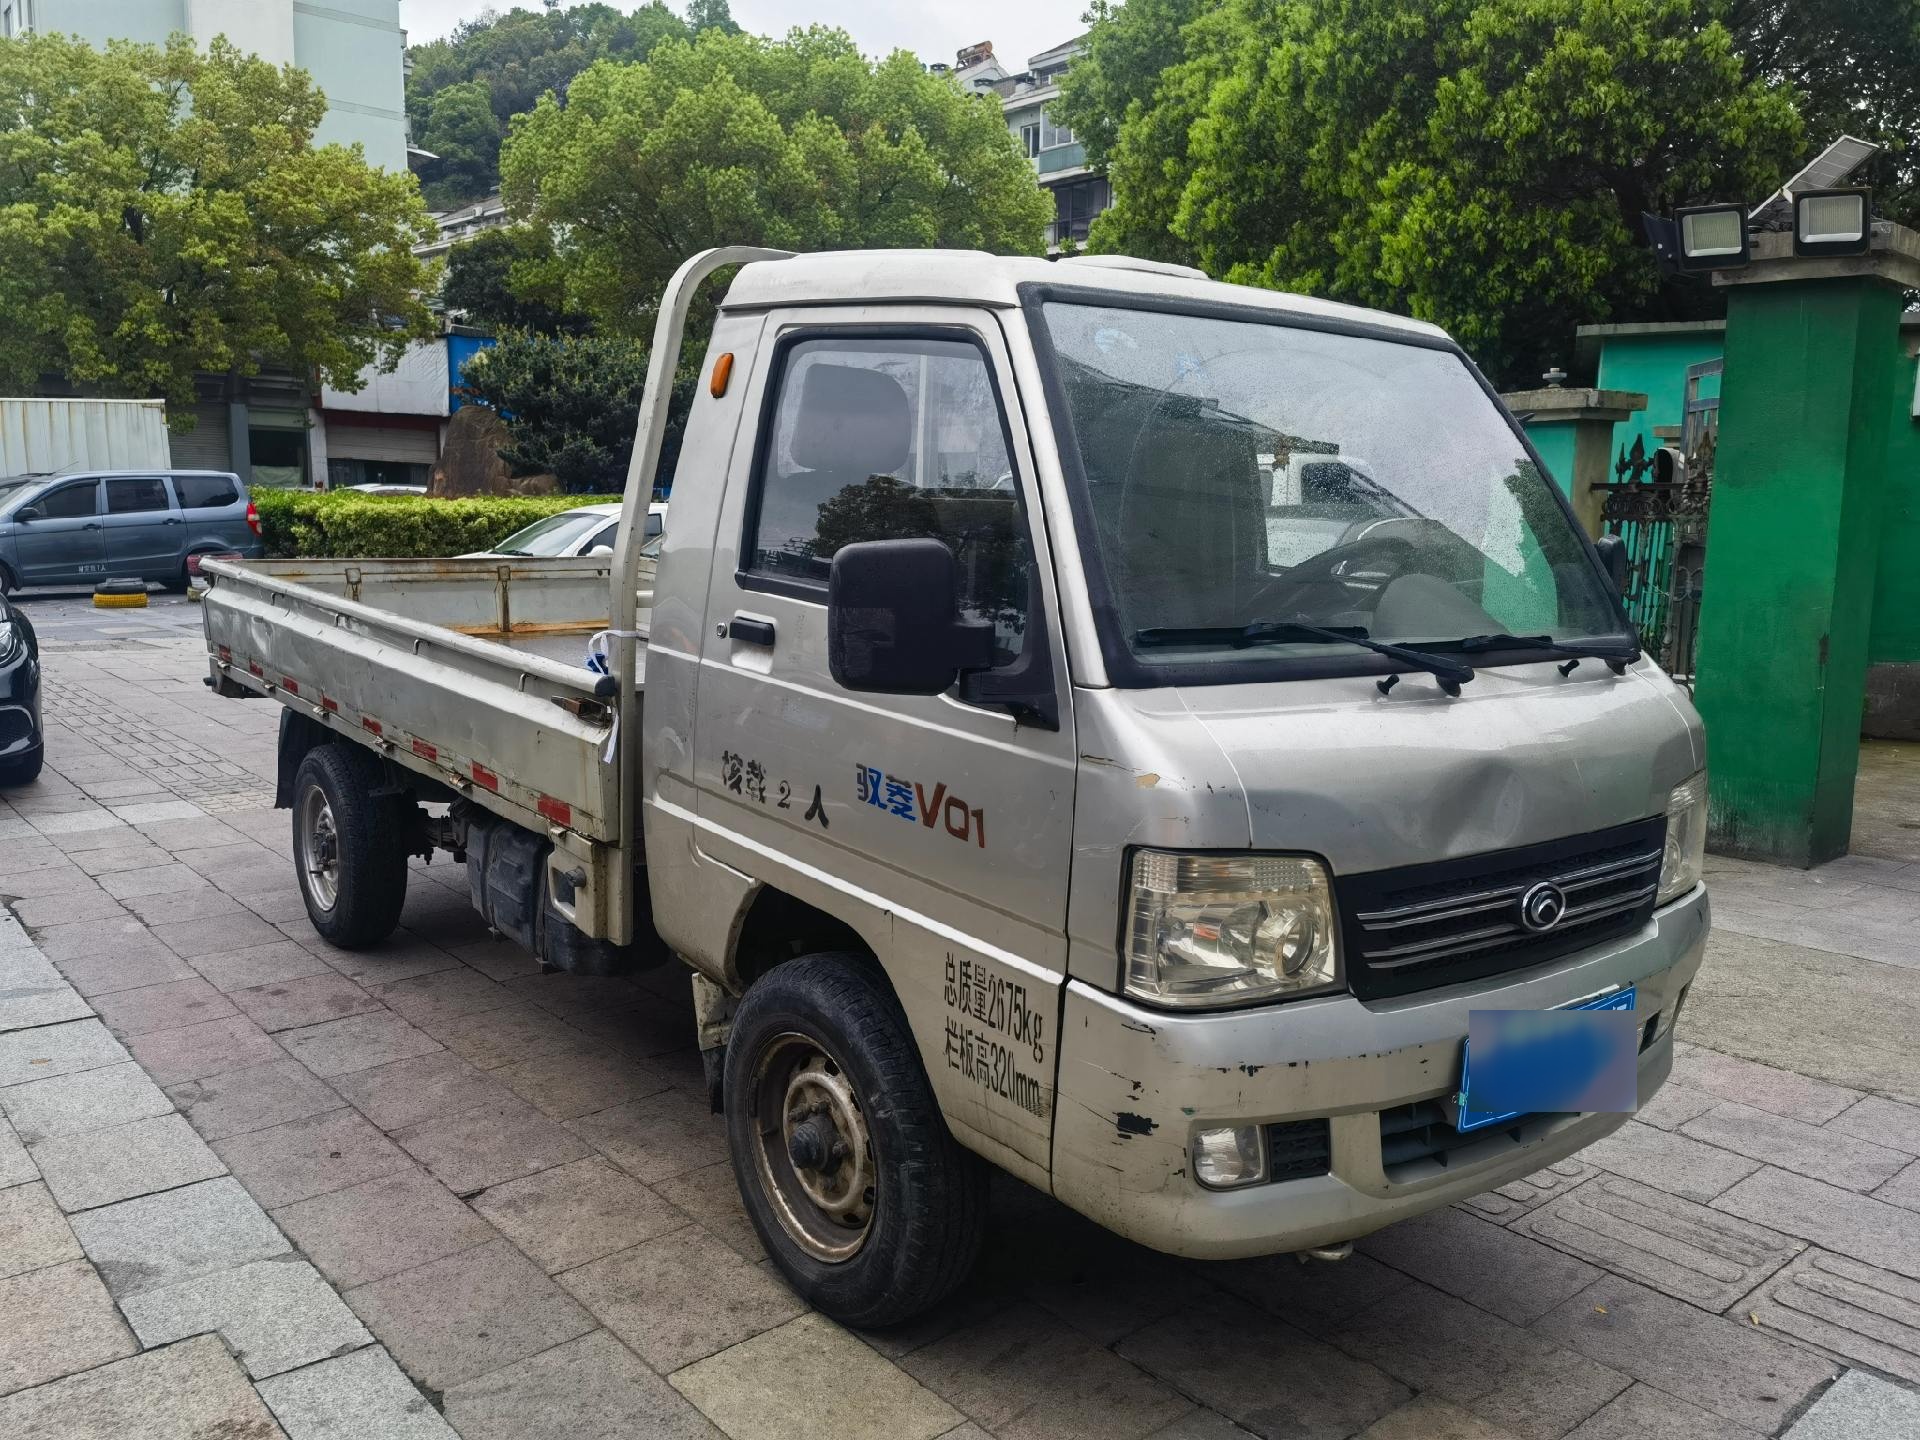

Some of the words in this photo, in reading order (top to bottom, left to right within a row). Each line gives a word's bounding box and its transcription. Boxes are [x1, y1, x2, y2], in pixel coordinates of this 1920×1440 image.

[944, 951, 1044, 1064] 总质量2675kg
[944, 1015, 1043, 1118] 栏板高320mm
